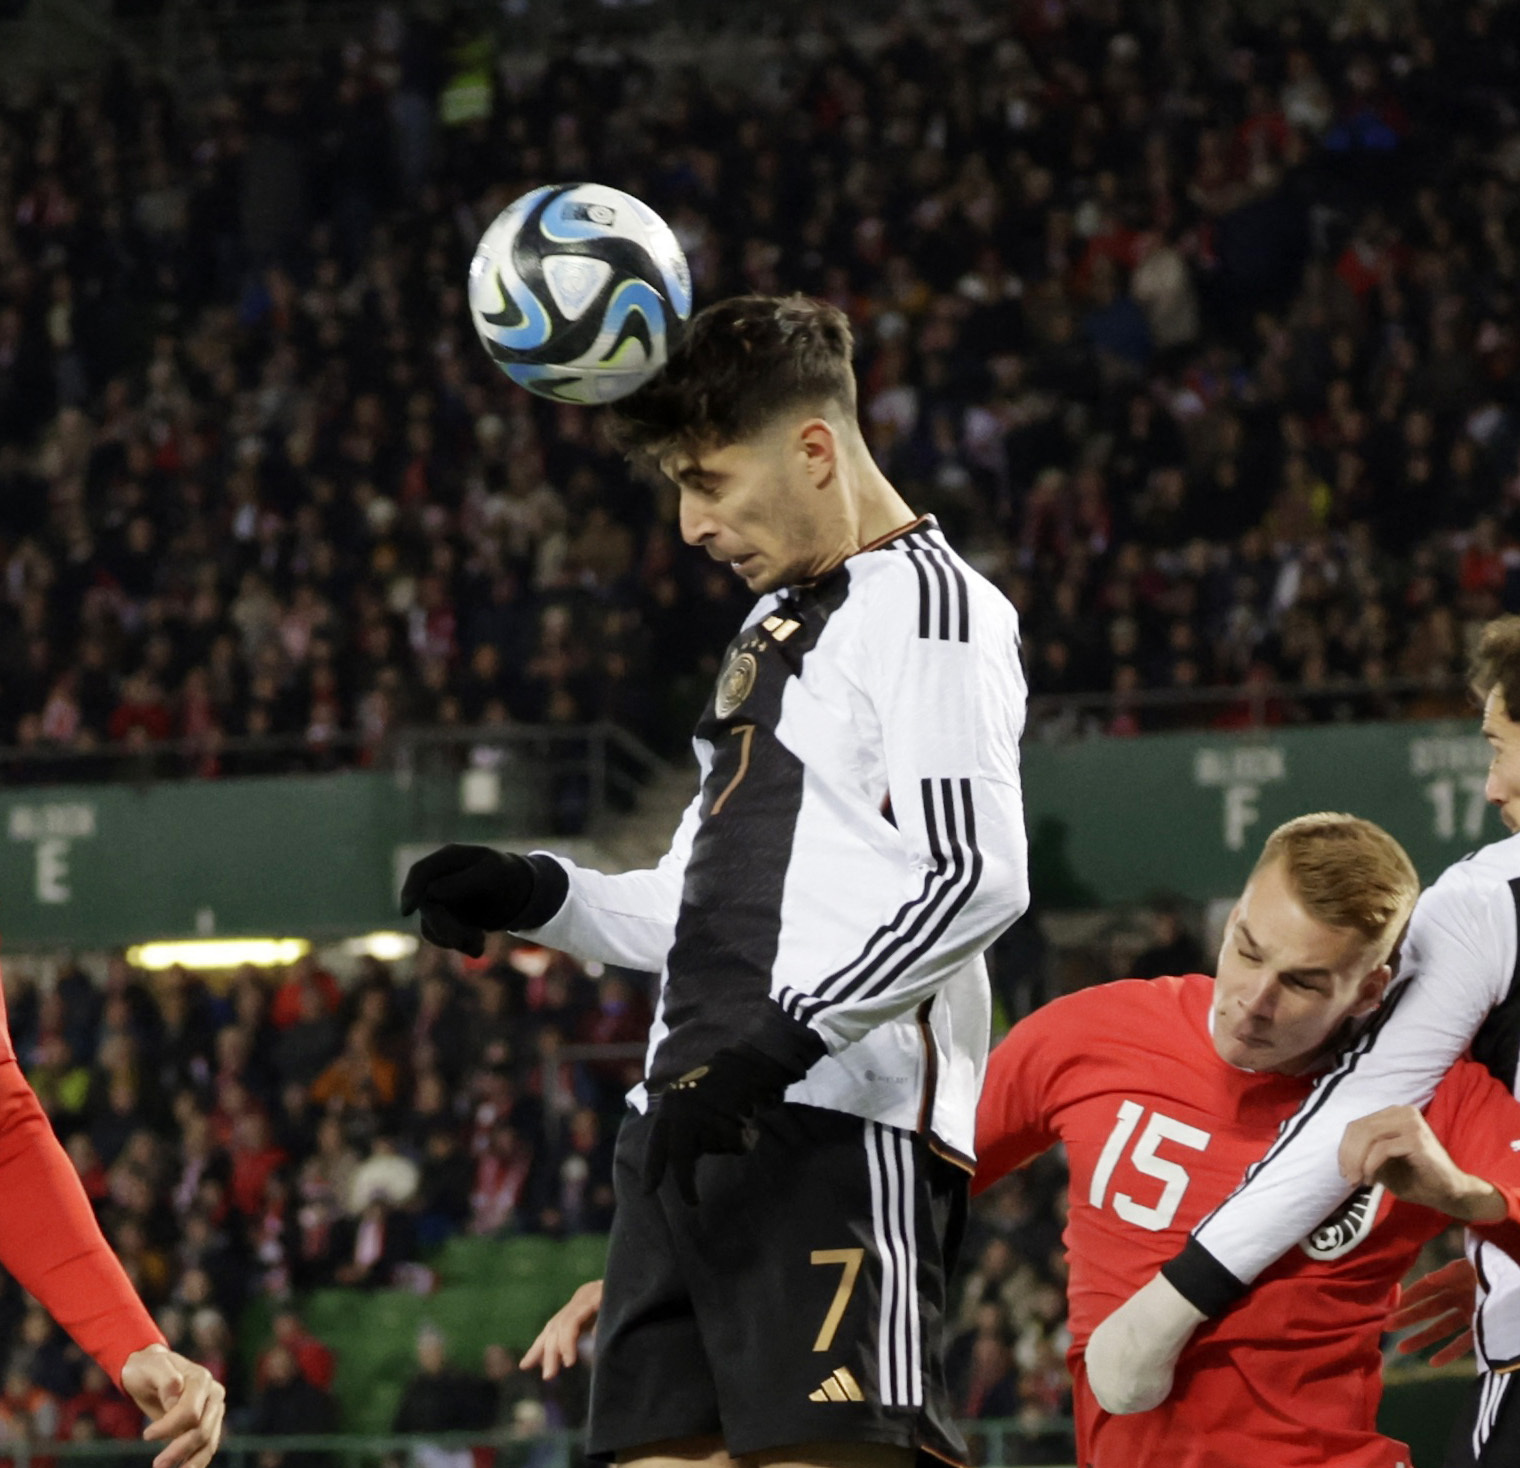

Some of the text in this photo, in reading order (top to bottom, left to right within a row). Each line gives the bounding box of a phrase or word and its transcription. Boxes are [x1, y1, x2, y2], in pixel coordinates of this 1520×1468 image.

[710, 725, 756, 815] 7
[1225, 786, 1260, 851] F
[36, 838, 72, 902] E
[1089, 1099, 1212, 1232] 15
[811, 1248, 865, 1352] 7
